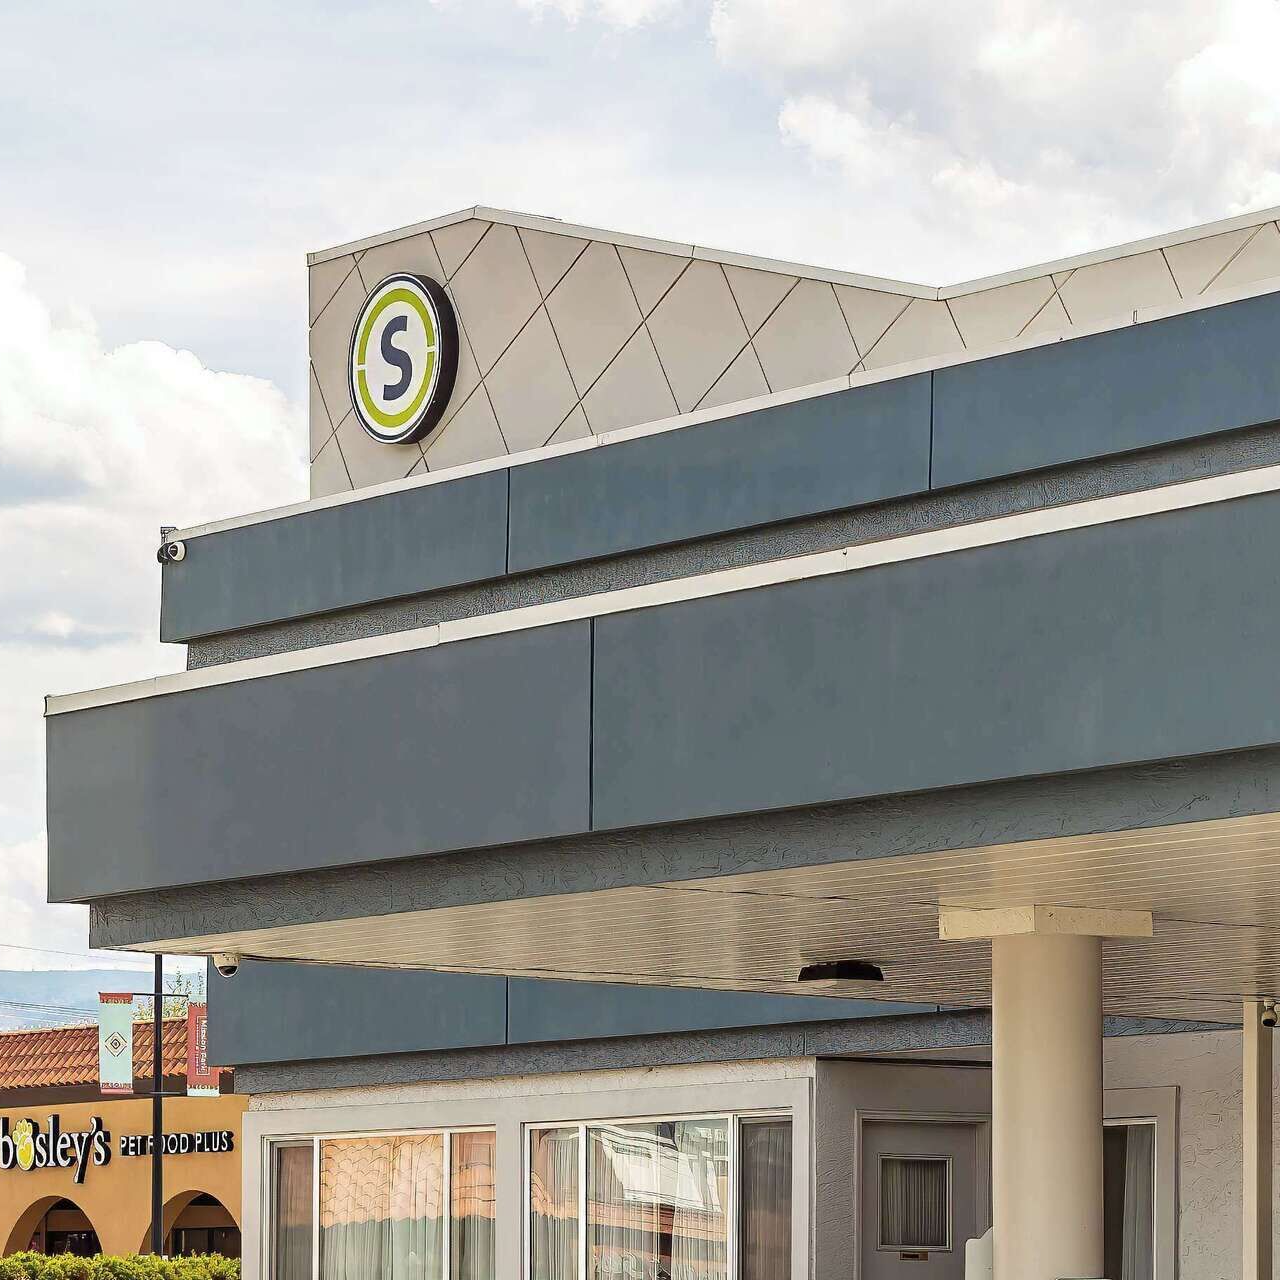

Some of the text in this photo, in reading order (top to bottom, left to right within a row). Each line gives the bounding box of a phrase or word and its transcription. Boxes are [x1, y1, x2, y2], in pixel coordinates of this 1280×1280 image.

[380, 315, 413, 401] S
[120, 1136, 142, 1156] PET
[195, 1131, 230, 1152] PLUS
